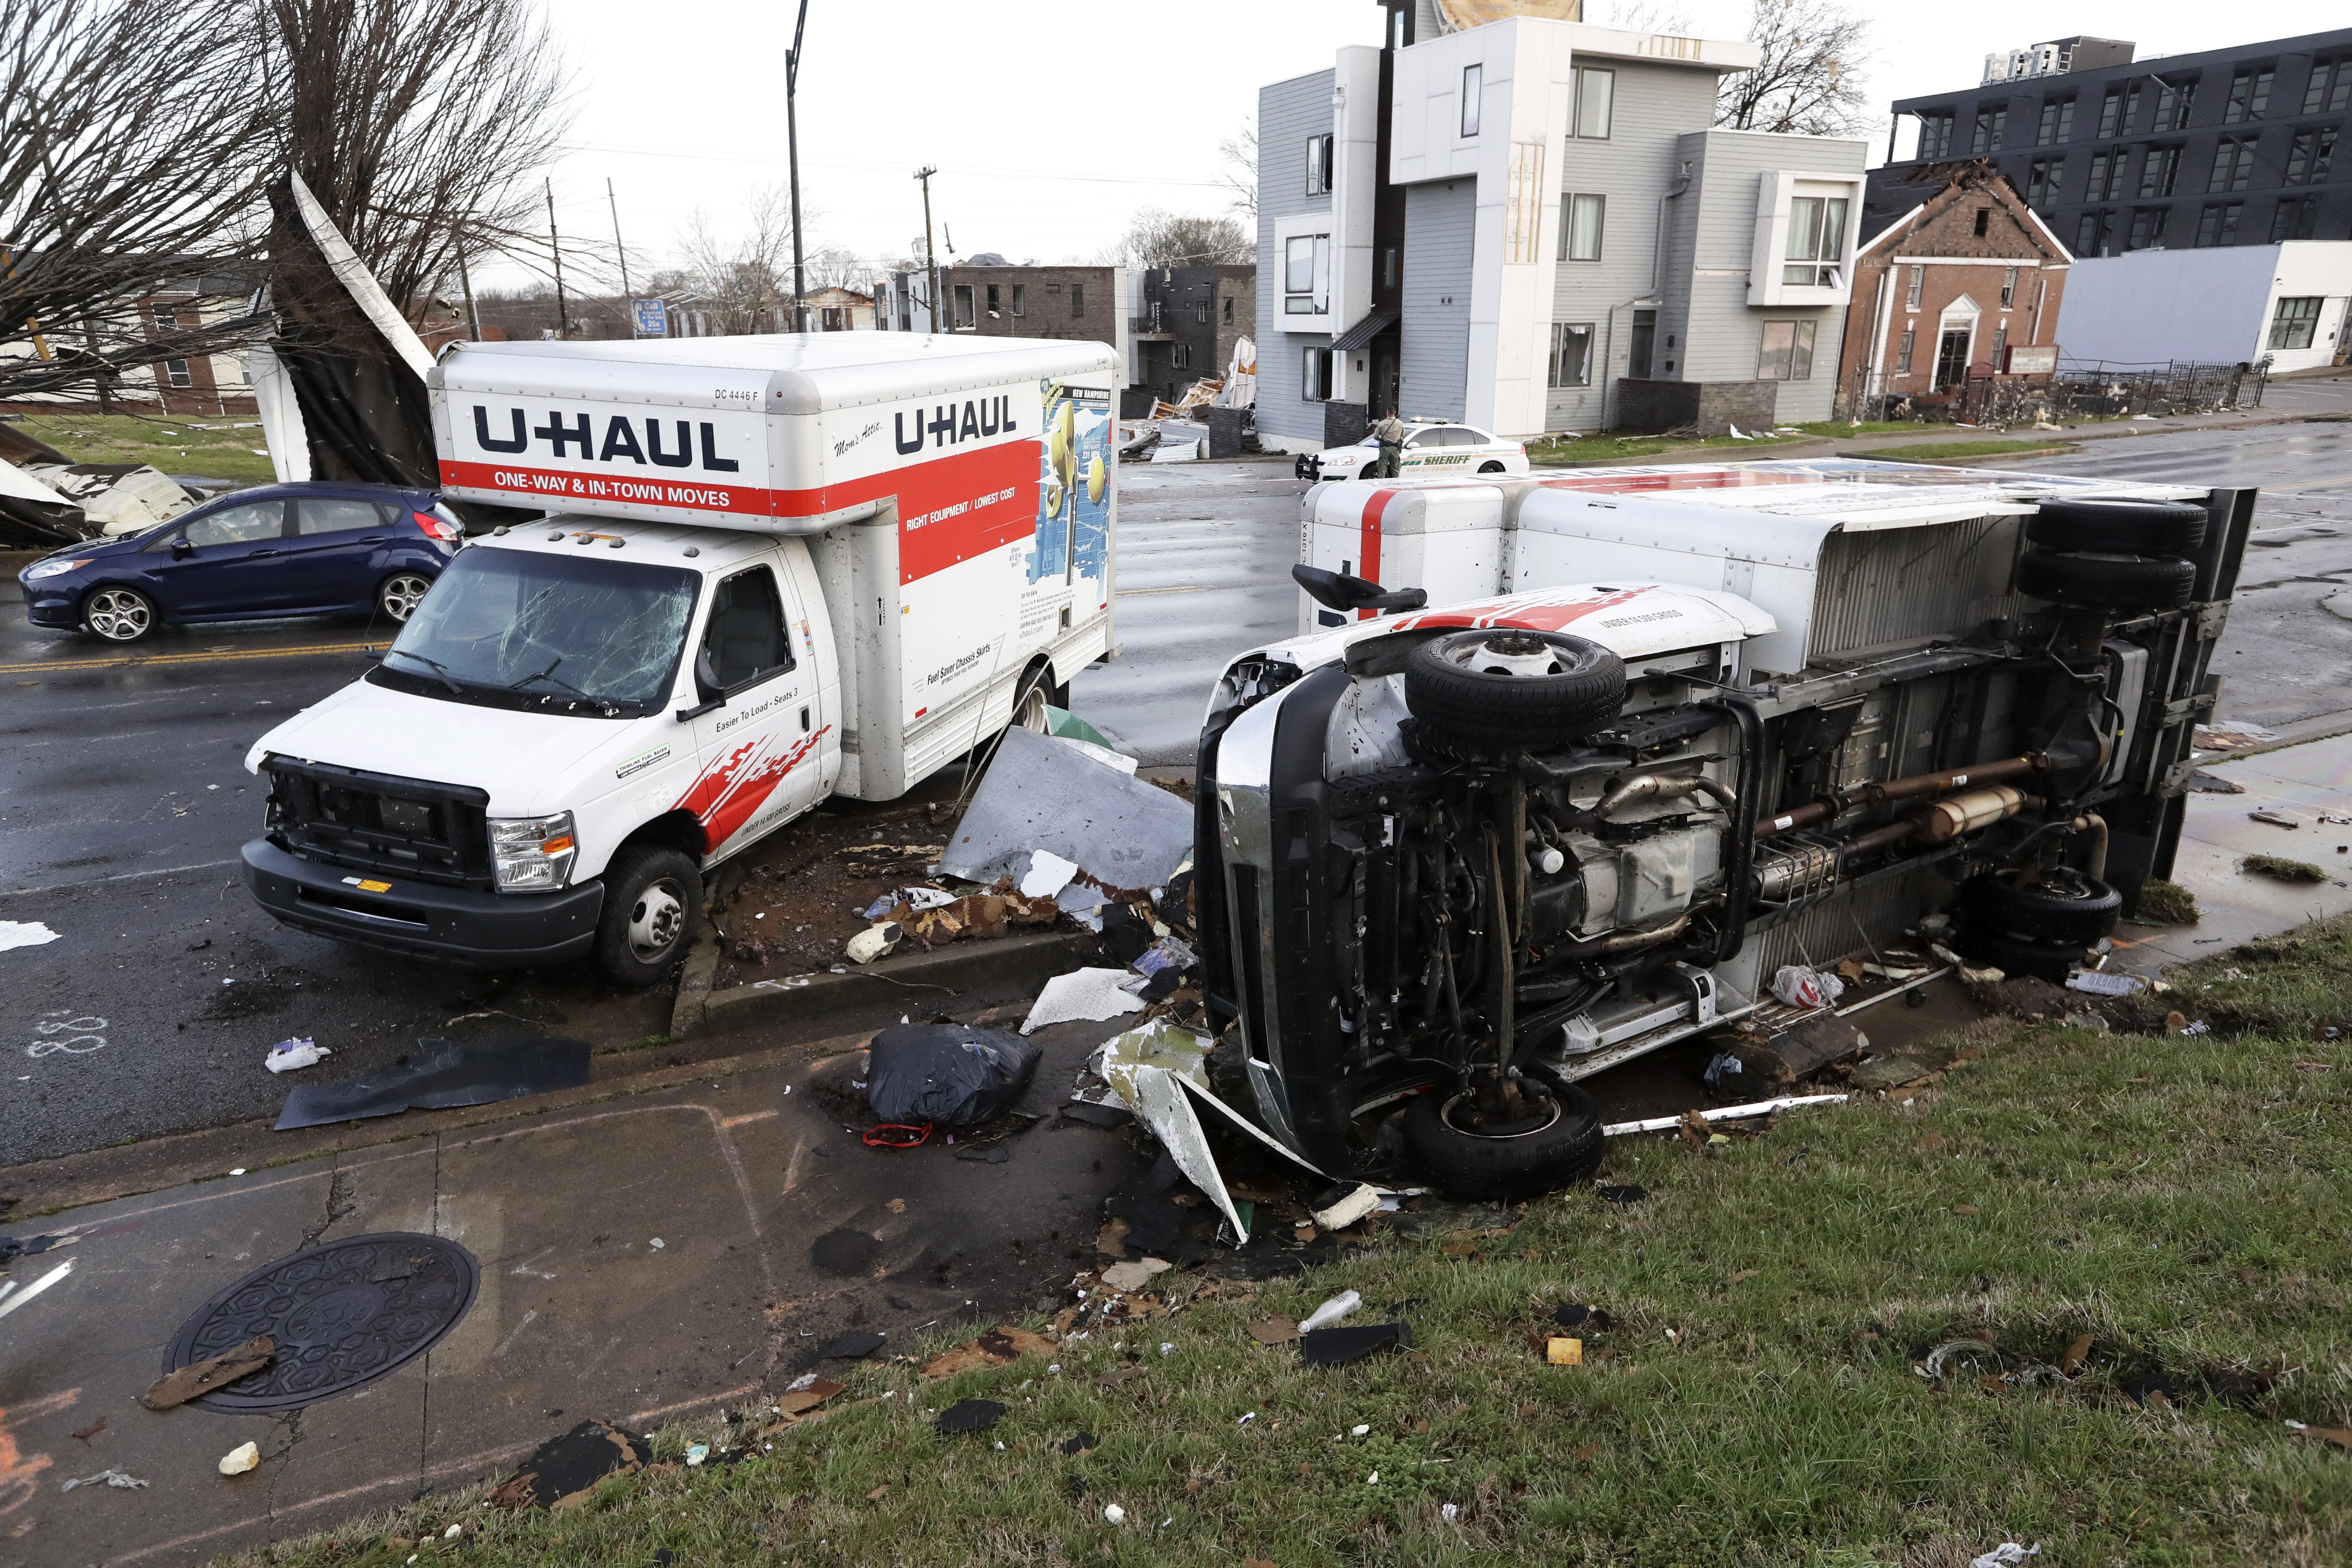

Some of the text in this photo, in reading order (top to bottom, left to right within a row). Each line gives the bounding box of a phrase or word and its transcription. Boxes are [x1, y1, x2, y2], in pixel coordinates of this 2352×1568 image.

[715, 389, 758, 401] DC 4446 F
[1072, 389, 1109, 399] NEW HAMPSHIRE
[834, 421, 880, 457] Mom's Attic
[1091, 450, 1100, 459] MPH
[1423, 455, 1471, 466] SHERIFF
[494, 471, 730, 506] ONE-WAY & IN-TOWN MOVES
[906, 514, 928, 532] RIGHT
[930, 501, 968, 524] EQUIPMENT
[974, 492, 999, 509] LOWEST
[1000, 487, 1015, 501] COST
[1599, 609, 1683, 628] UNDER 14,500 GROSS
[1019, 625, 1044, 639] uhaul.com
[928, 670, 939, 686] Fuel
[956, 651, 975, 670] Chassis
[976, 643, 990, 658] Skirts
[941, 674, 953, 686] OPTIMIZE
[968, 659, 980, 671] ECONOMY
[716, 687, 798, 733] Easier To Load Seats 3
[619, 759, 640, 772] TRIMLINE
[741, 802, 791, 836] UNDER 14,500 GROSS
